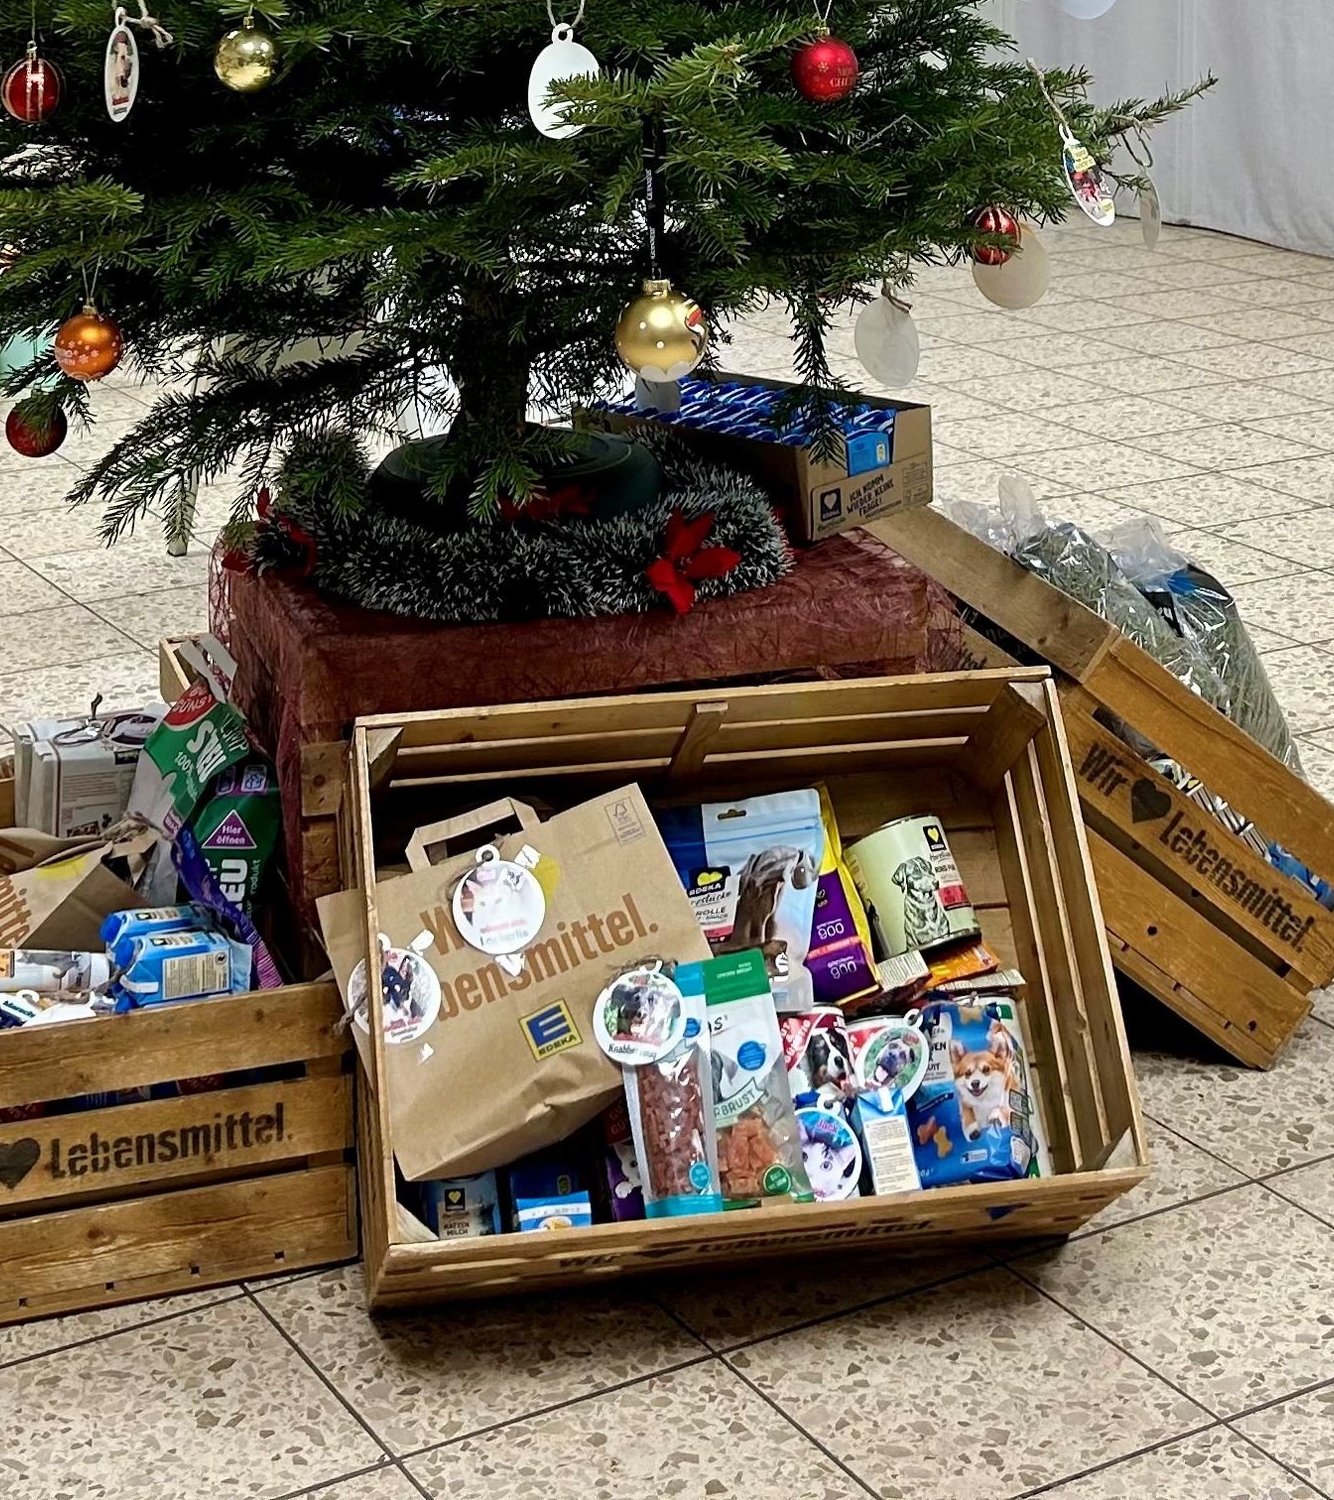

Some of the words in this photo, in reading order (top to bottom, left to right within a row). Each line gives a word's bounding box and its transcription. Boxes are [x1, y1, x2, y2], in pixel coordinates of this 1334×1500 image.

[222, 824, 243, 834] Hier
[216, 835, 245, 845] öffnen
[1078, 742, 1129, 798] Wir
[1159, 810, 1315, 952] Lebensmittel.
[689, 882, 722, 897] EDEKA
[538, 1033, 577, 1056] EDEKA
[50, 1102, 293, 1180] Lebensmittel.
[444, 1221, 470, 1230] KATZEN
[446, 1228, 469, 1237] MILCH
